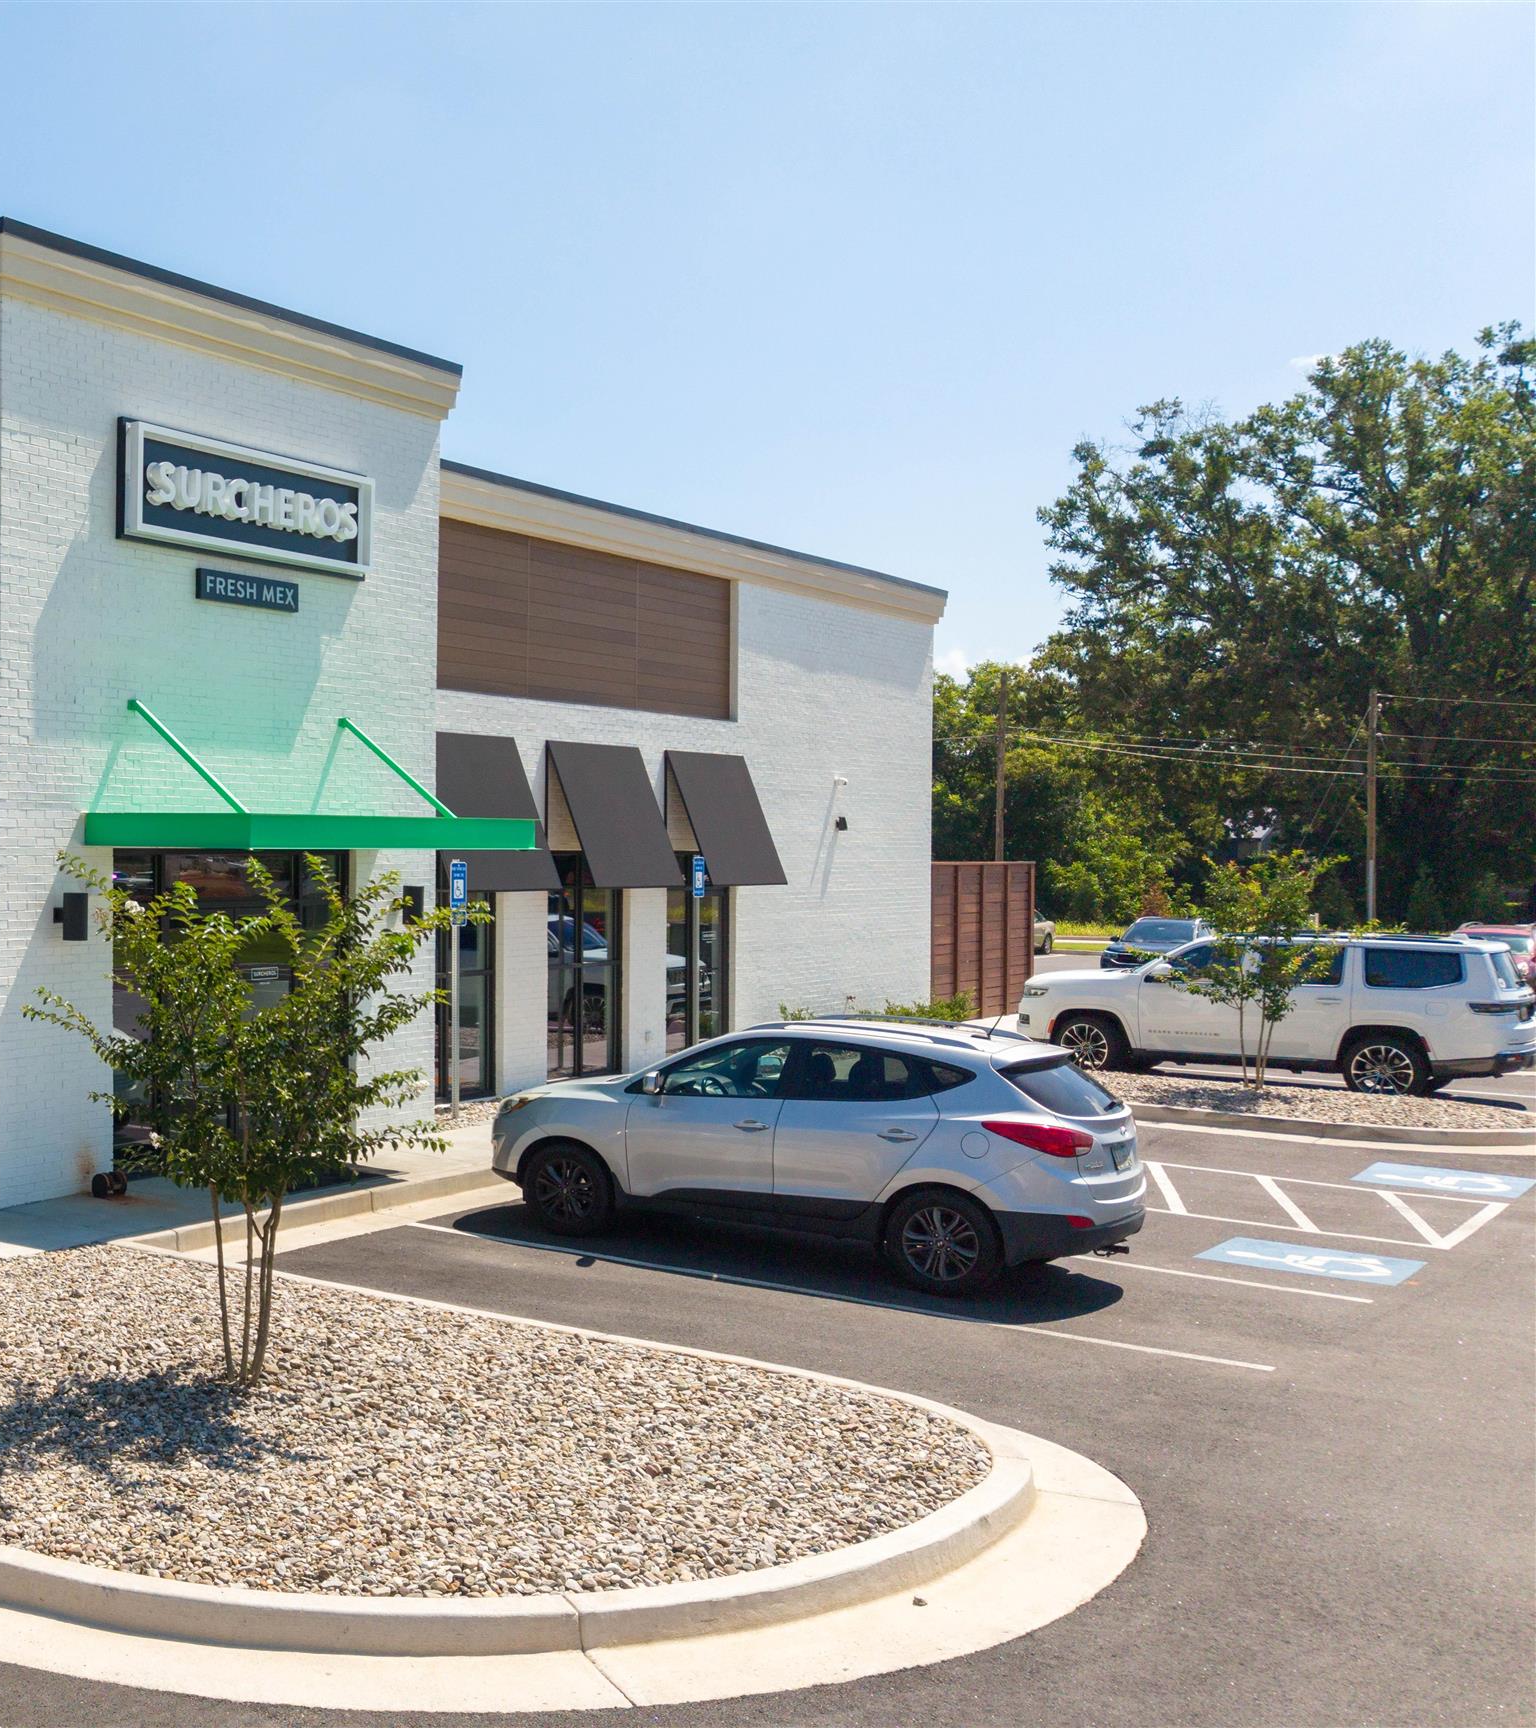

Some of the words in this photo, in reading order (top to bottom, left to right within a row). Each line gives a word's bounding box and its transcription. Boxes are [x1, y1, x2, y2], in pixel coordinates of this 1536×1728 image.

[145, 461, 358, 542] SURCHEROS
[205, 575, 257, 600] FRESH
[262, 584, 296, 608] MEX
